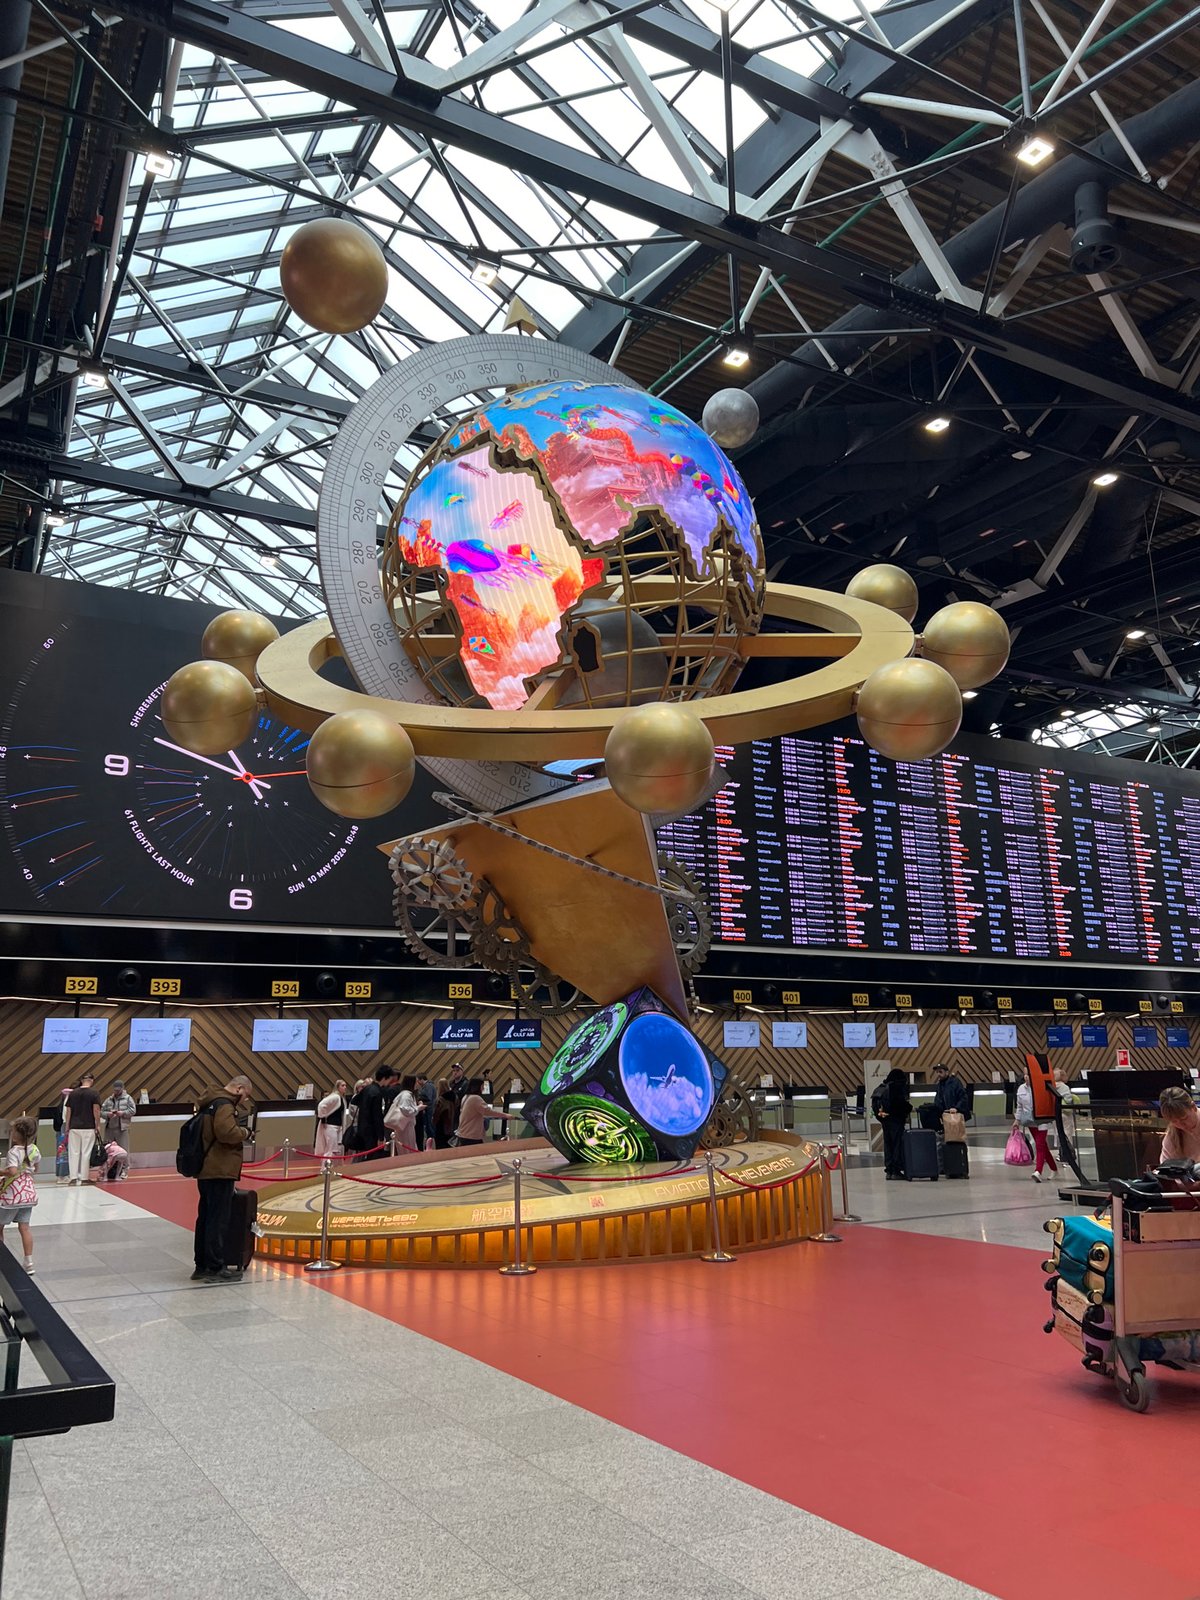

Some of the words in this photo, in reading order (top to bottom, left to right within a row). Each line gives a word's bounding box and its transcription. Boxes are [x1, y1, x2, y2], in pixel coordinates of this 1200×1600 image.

[477, 363, 498, 375] 350
[446, 369, 466, 385] 340
[487, 376, 498, 386] 10
[417, 383, 437, 400] 330
[456, 383, 469, 394] 20
[429, 396, 441, 409] 30
[393, 403, 412, 423] 320
[406, 416, 418, 429] 40
[373, 429, 391, 451] 310
[387, 441, 399, 455] 50
[360, 461, 375, 485] 300
[373, 473, 385, 487] 60
[353, 499, 366, 523] 290
[367, 509, 377, 522] 70
[352, 540, 364, 565] 280
[366, 545, 376, 560] 80
[357, 581, 372, 605] 270
[371, 585, 382, 600] 90
[370, 623, 388, 648] 260
[383, 622, 398, 642] 100
[389, 662, 409, 686] 250
[400, 658, 417, 679] 110
[104, 754, 130, 777] 9
[509, 775, 532, 792] 210
[124, 809, 134, 819] 61
[129, 820, 155, 853] FLIGHTS
[152, 852, 172, 870] LAST
[170, 868, 195, 886] HOUR
[288, 882, 305, 894] SUN
[307, 875, 317, 884] 10
[316, 863, 332, 878] MAY
[331, 848, 347, 865] 2026
[345, 825, 359, 845] 10:48
[23, 868, 33, 880] 40
[229, 889, 253, 910] 6
[67, 979, 96, 991] 392
[152, 981, 179, 993] 393
[273, 983, 298, 995] 394
[347, 984, 370, 995] 395
[450, 987, 471, 996] 396
[735, 992, 751, 1001] 400
[784, 993, 799, 1002] 401
[853, 995, 868, 1004] 402
[896, 996, 911, 1005] 403
[959, 998, 973, 1007] 404
[998, 999, 1011, 1008] 405
[1054, 1000, 1067, 1008] 406
[1090, 1001, 1102, 1009] 407
[655, 1177, 720, 1197] AVIATION
[331, 1214, 419, 1224] ШЕРЕМЕТЬЕВО
